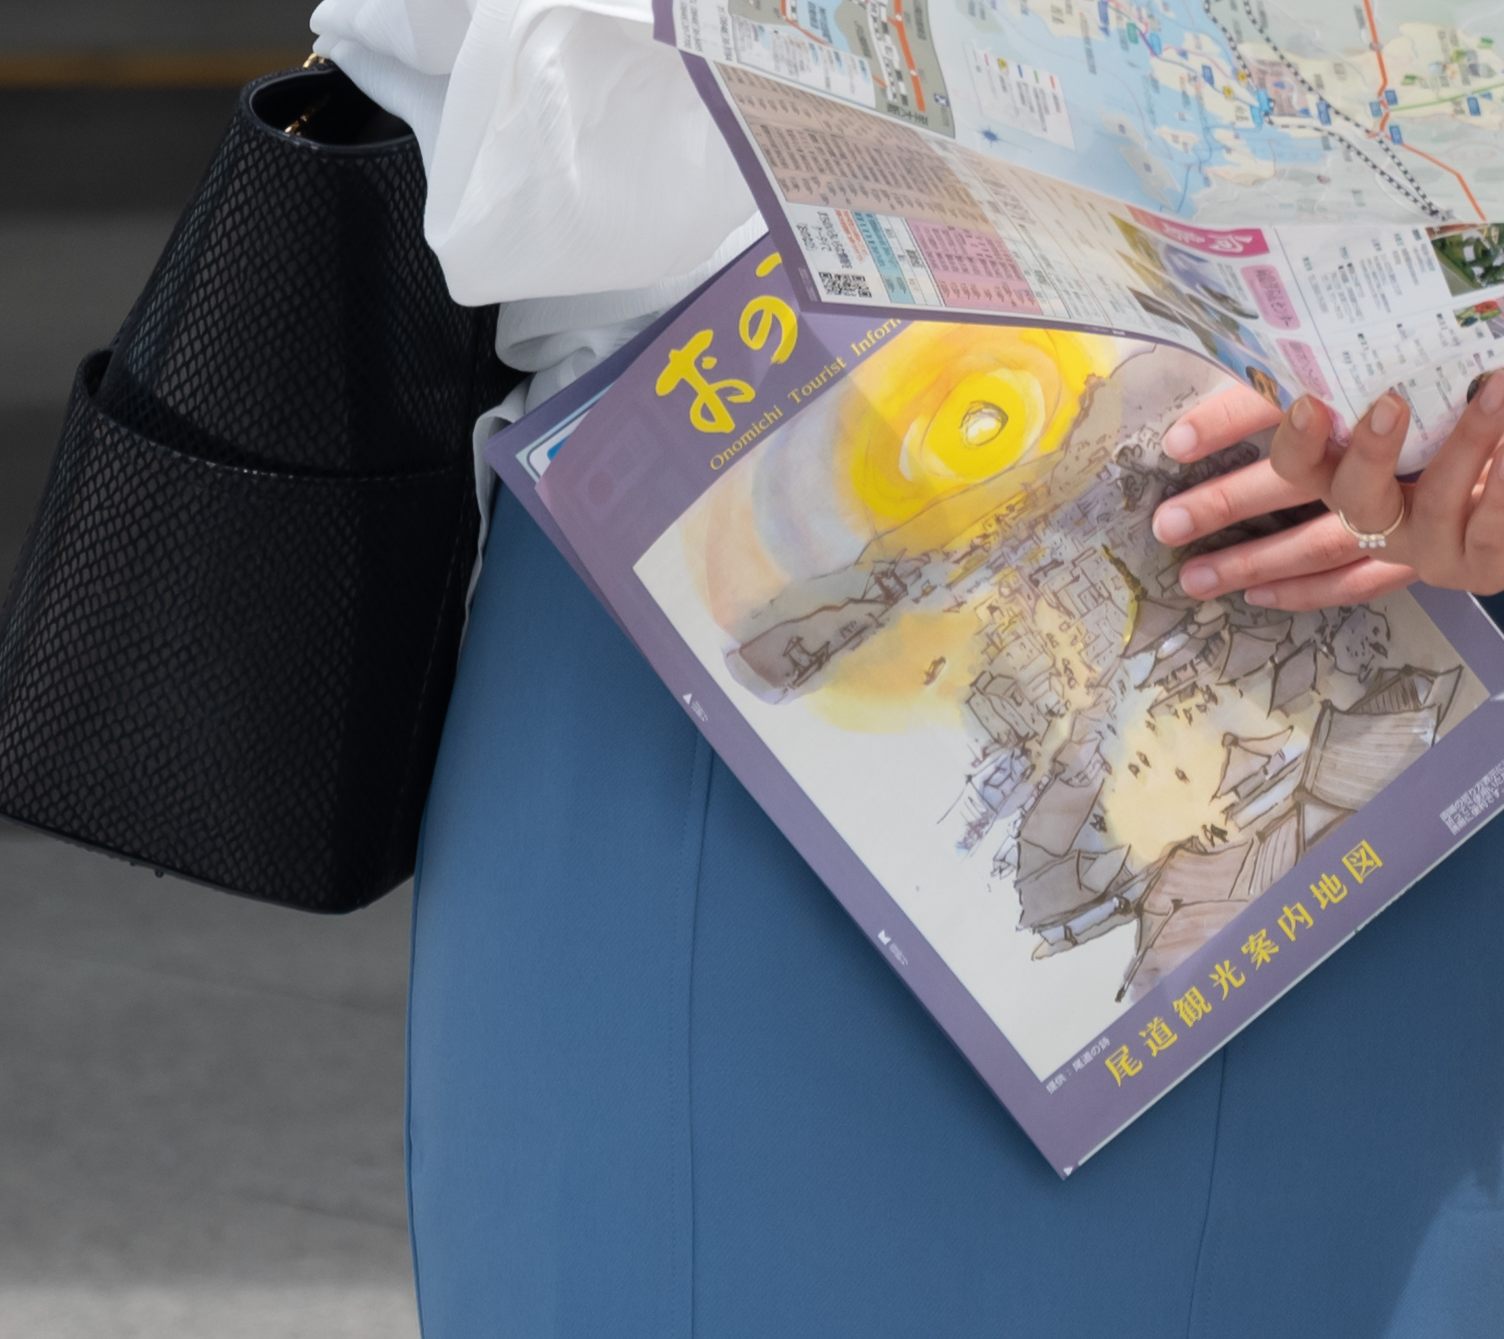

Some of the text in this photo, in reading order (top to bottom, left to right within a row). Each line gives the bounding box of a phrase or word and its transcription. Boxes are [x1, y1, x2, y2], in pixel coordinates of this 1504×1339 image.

[656, 252, 798, 434] おの
[709, 405, 783, 470] Onomichi
[787, 356, 846, 404] Tourist
[1103, 839, 1384, 1087] 尾道観光案内地図
